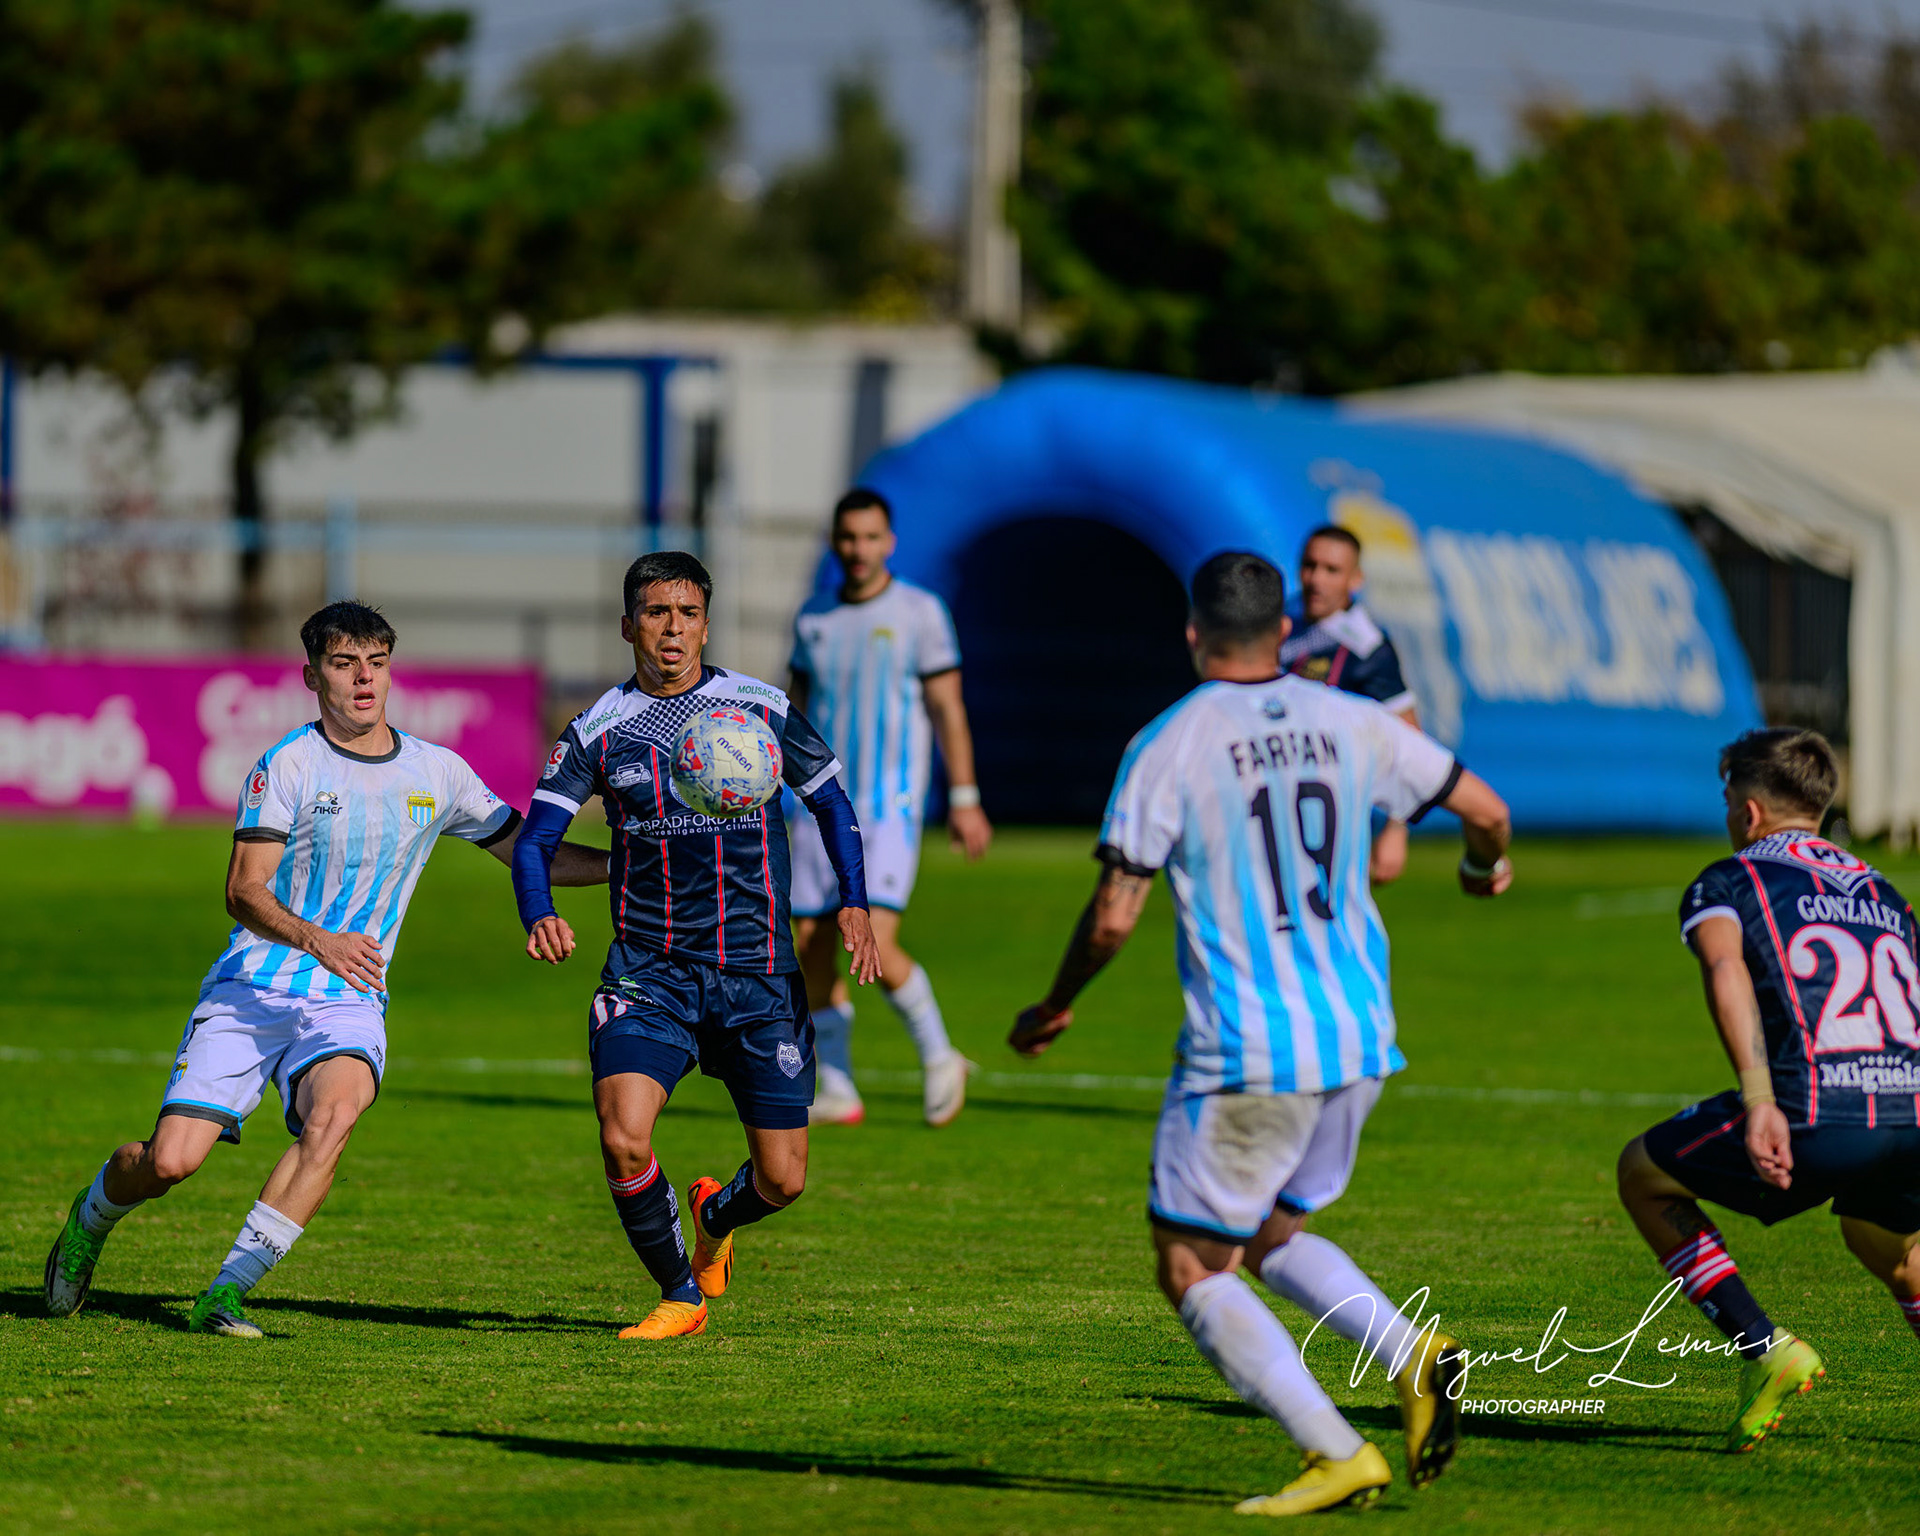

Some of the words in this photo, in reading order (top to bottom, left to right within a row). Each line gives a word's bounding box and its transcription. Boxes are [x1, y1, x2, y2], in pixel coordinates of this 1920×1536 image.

[736, 685, 782, 706] MOLISAC.CL
[716, 736, 754, 773] molten
[1250, 782, 1336, 931] 19
[1797, 894, 1906, 939] GONZALEZ
[1788, 923, 1920, 1054] 20
